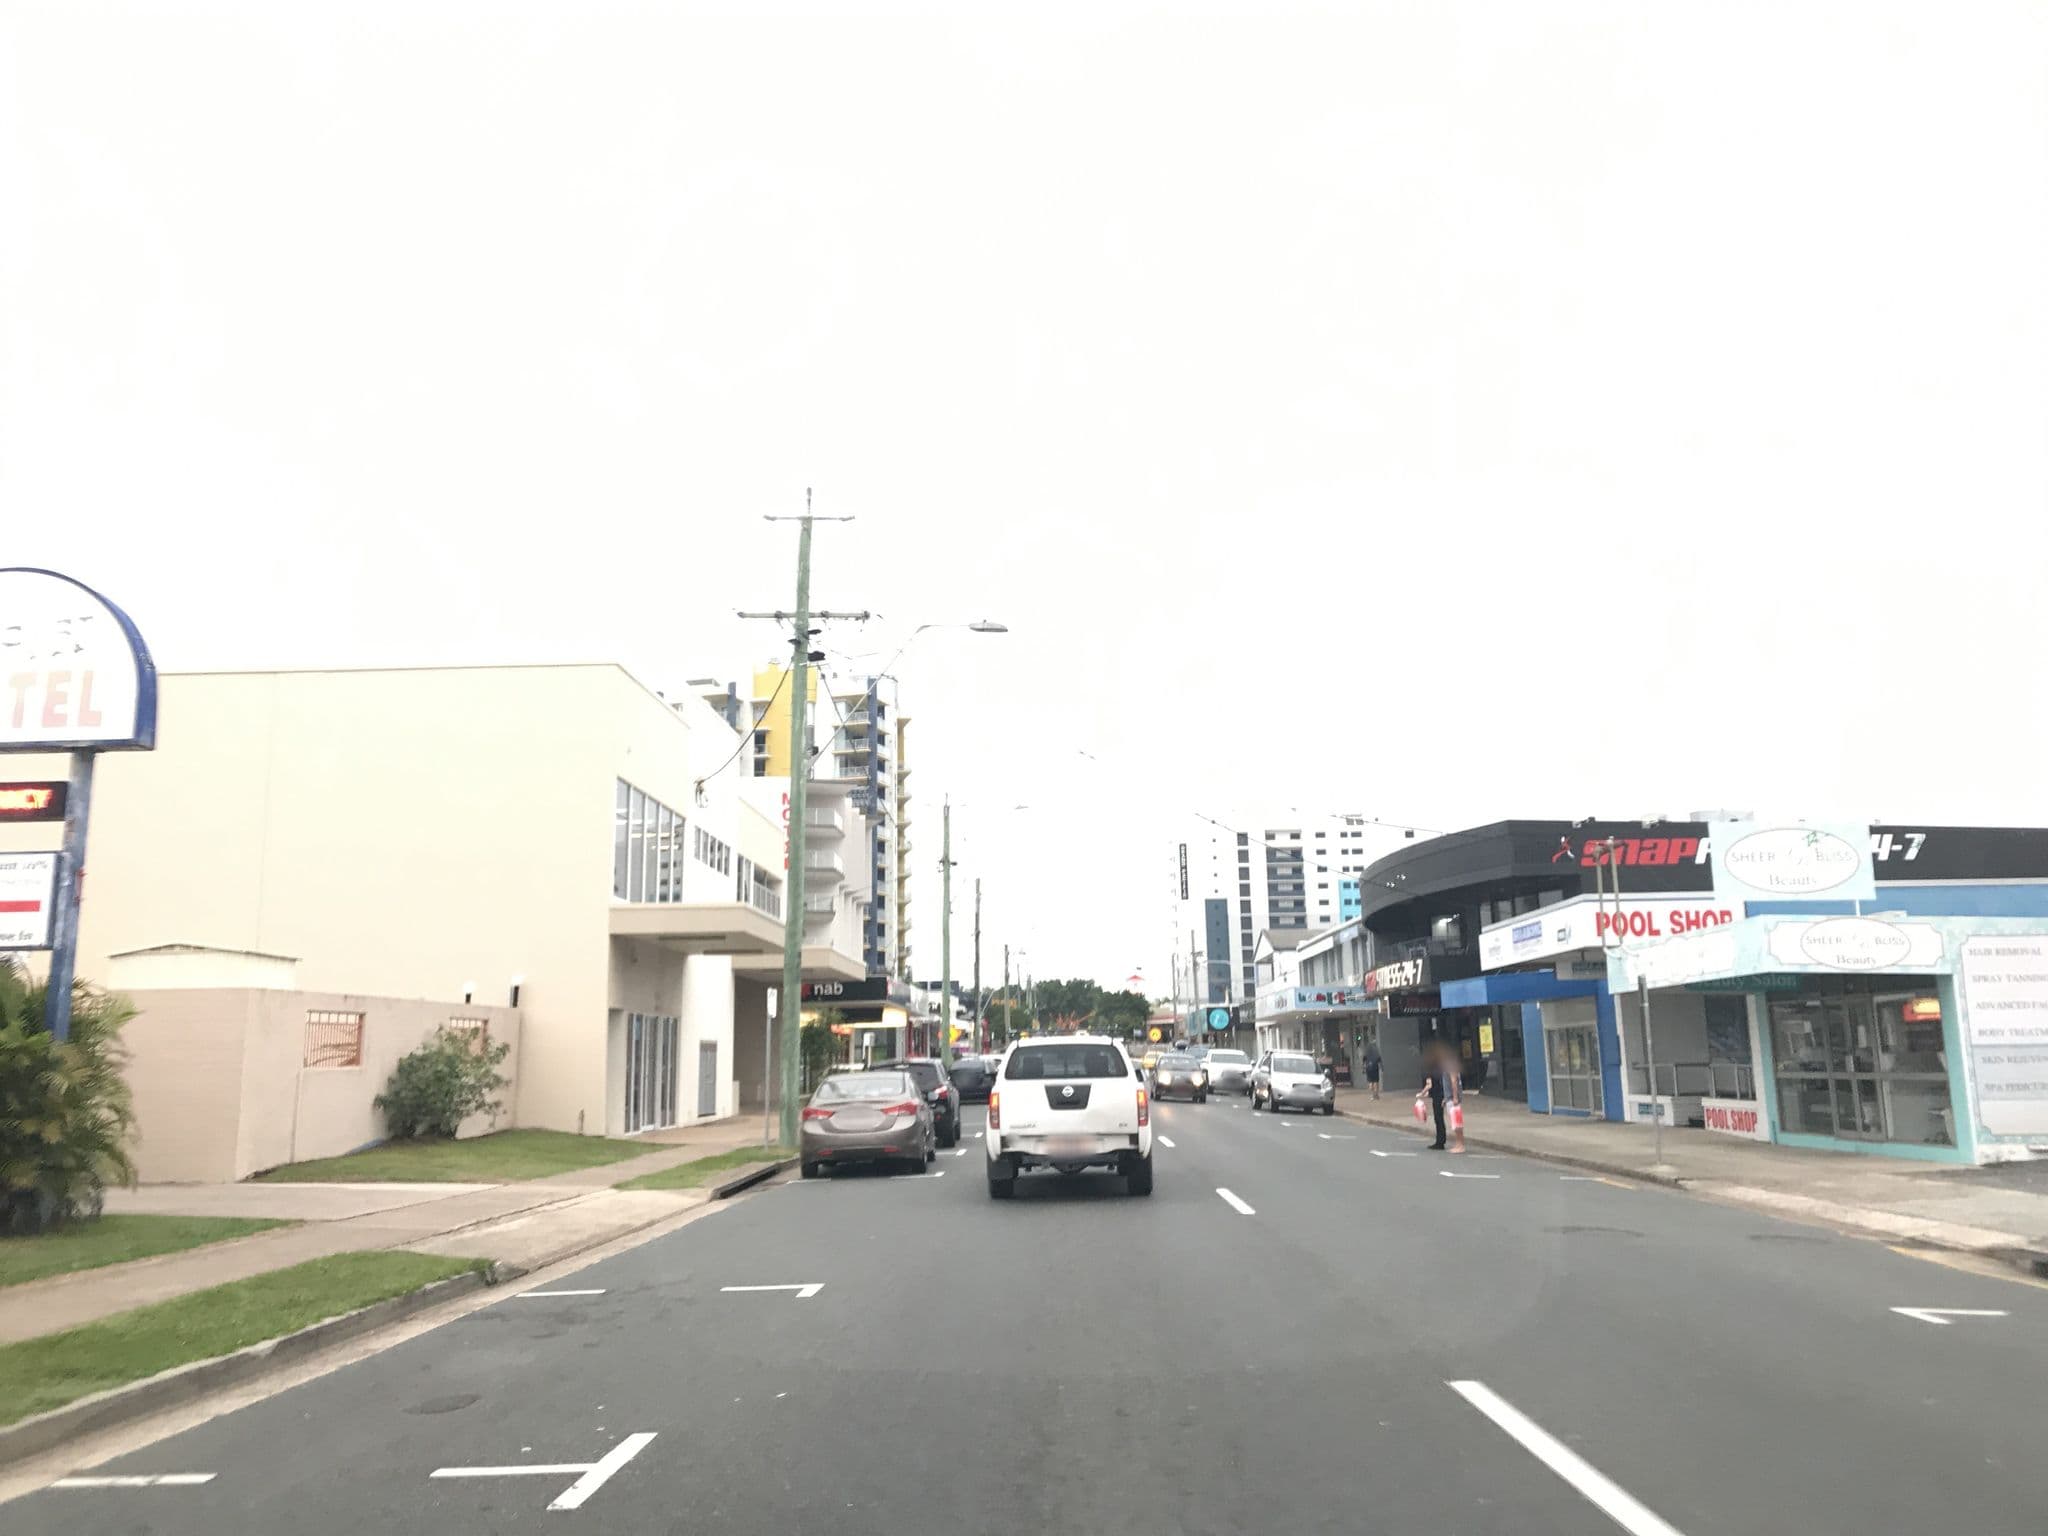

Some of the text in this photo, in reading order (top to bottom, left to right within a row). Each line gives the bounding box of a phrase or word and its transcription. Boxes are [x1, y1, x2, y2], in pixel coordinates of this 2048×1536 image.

[1595, 911, 1661, 937] POOL
[1970, 947, 2042, 957] HAIR REMOVAL
[1972, 974, 2002, 984] SPRAY
[813, 981, 844, 996] nab
[1975, 1001, 2031, 1010] ADVANCED
[1978, 1028, 2006, 1038] BODY
[1984, 1082, 2002, 1093] SPA
[1705, 1107, 1758, 1133] POOL SHOP
